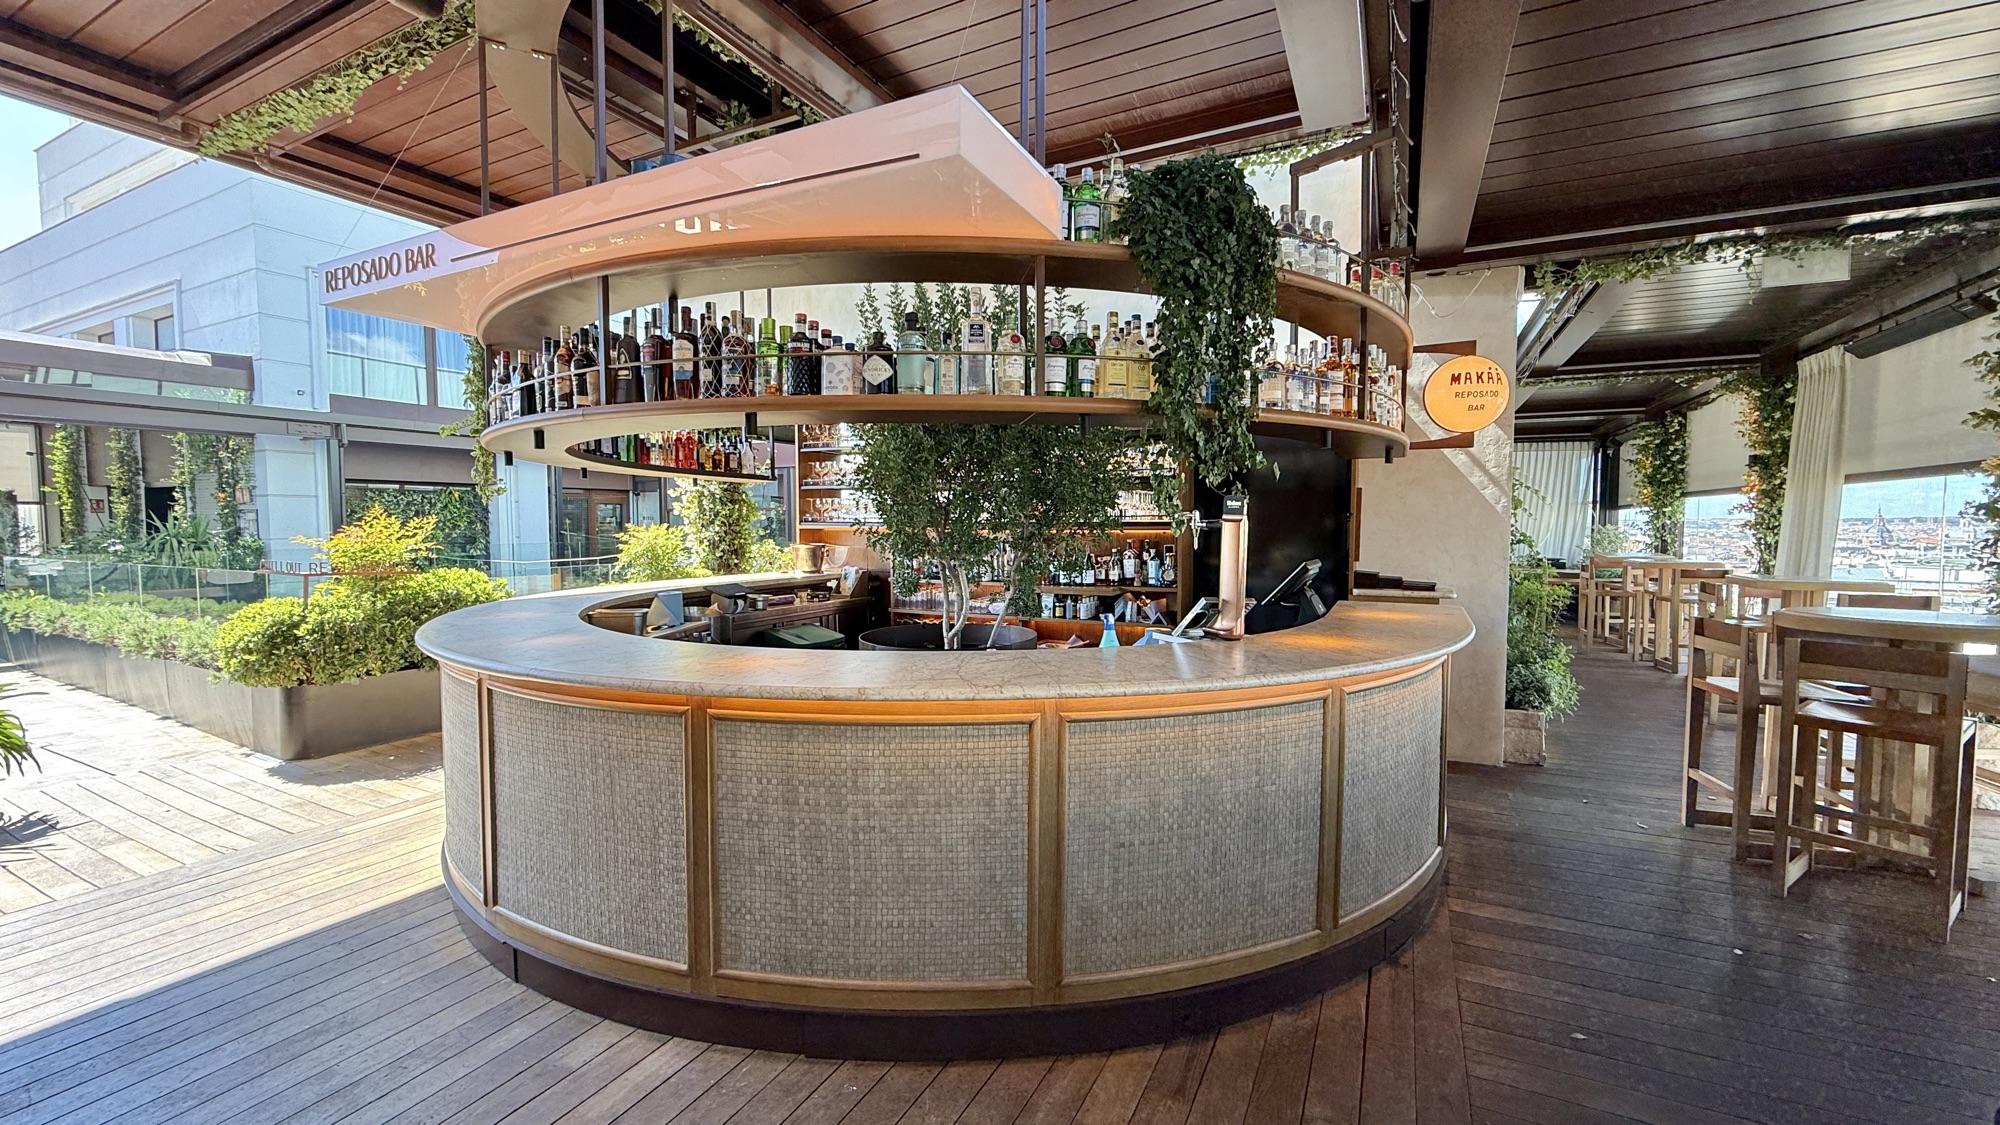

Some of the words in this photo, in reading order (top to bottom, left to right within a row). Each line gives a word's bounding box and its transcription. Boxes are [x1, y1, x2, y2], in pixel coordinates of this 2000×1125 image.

[325, 252, 402, 293] REPOSADO
[404, 243, 438, 273] BAR
[1454, 390, 1499, 399] REPOSADO
